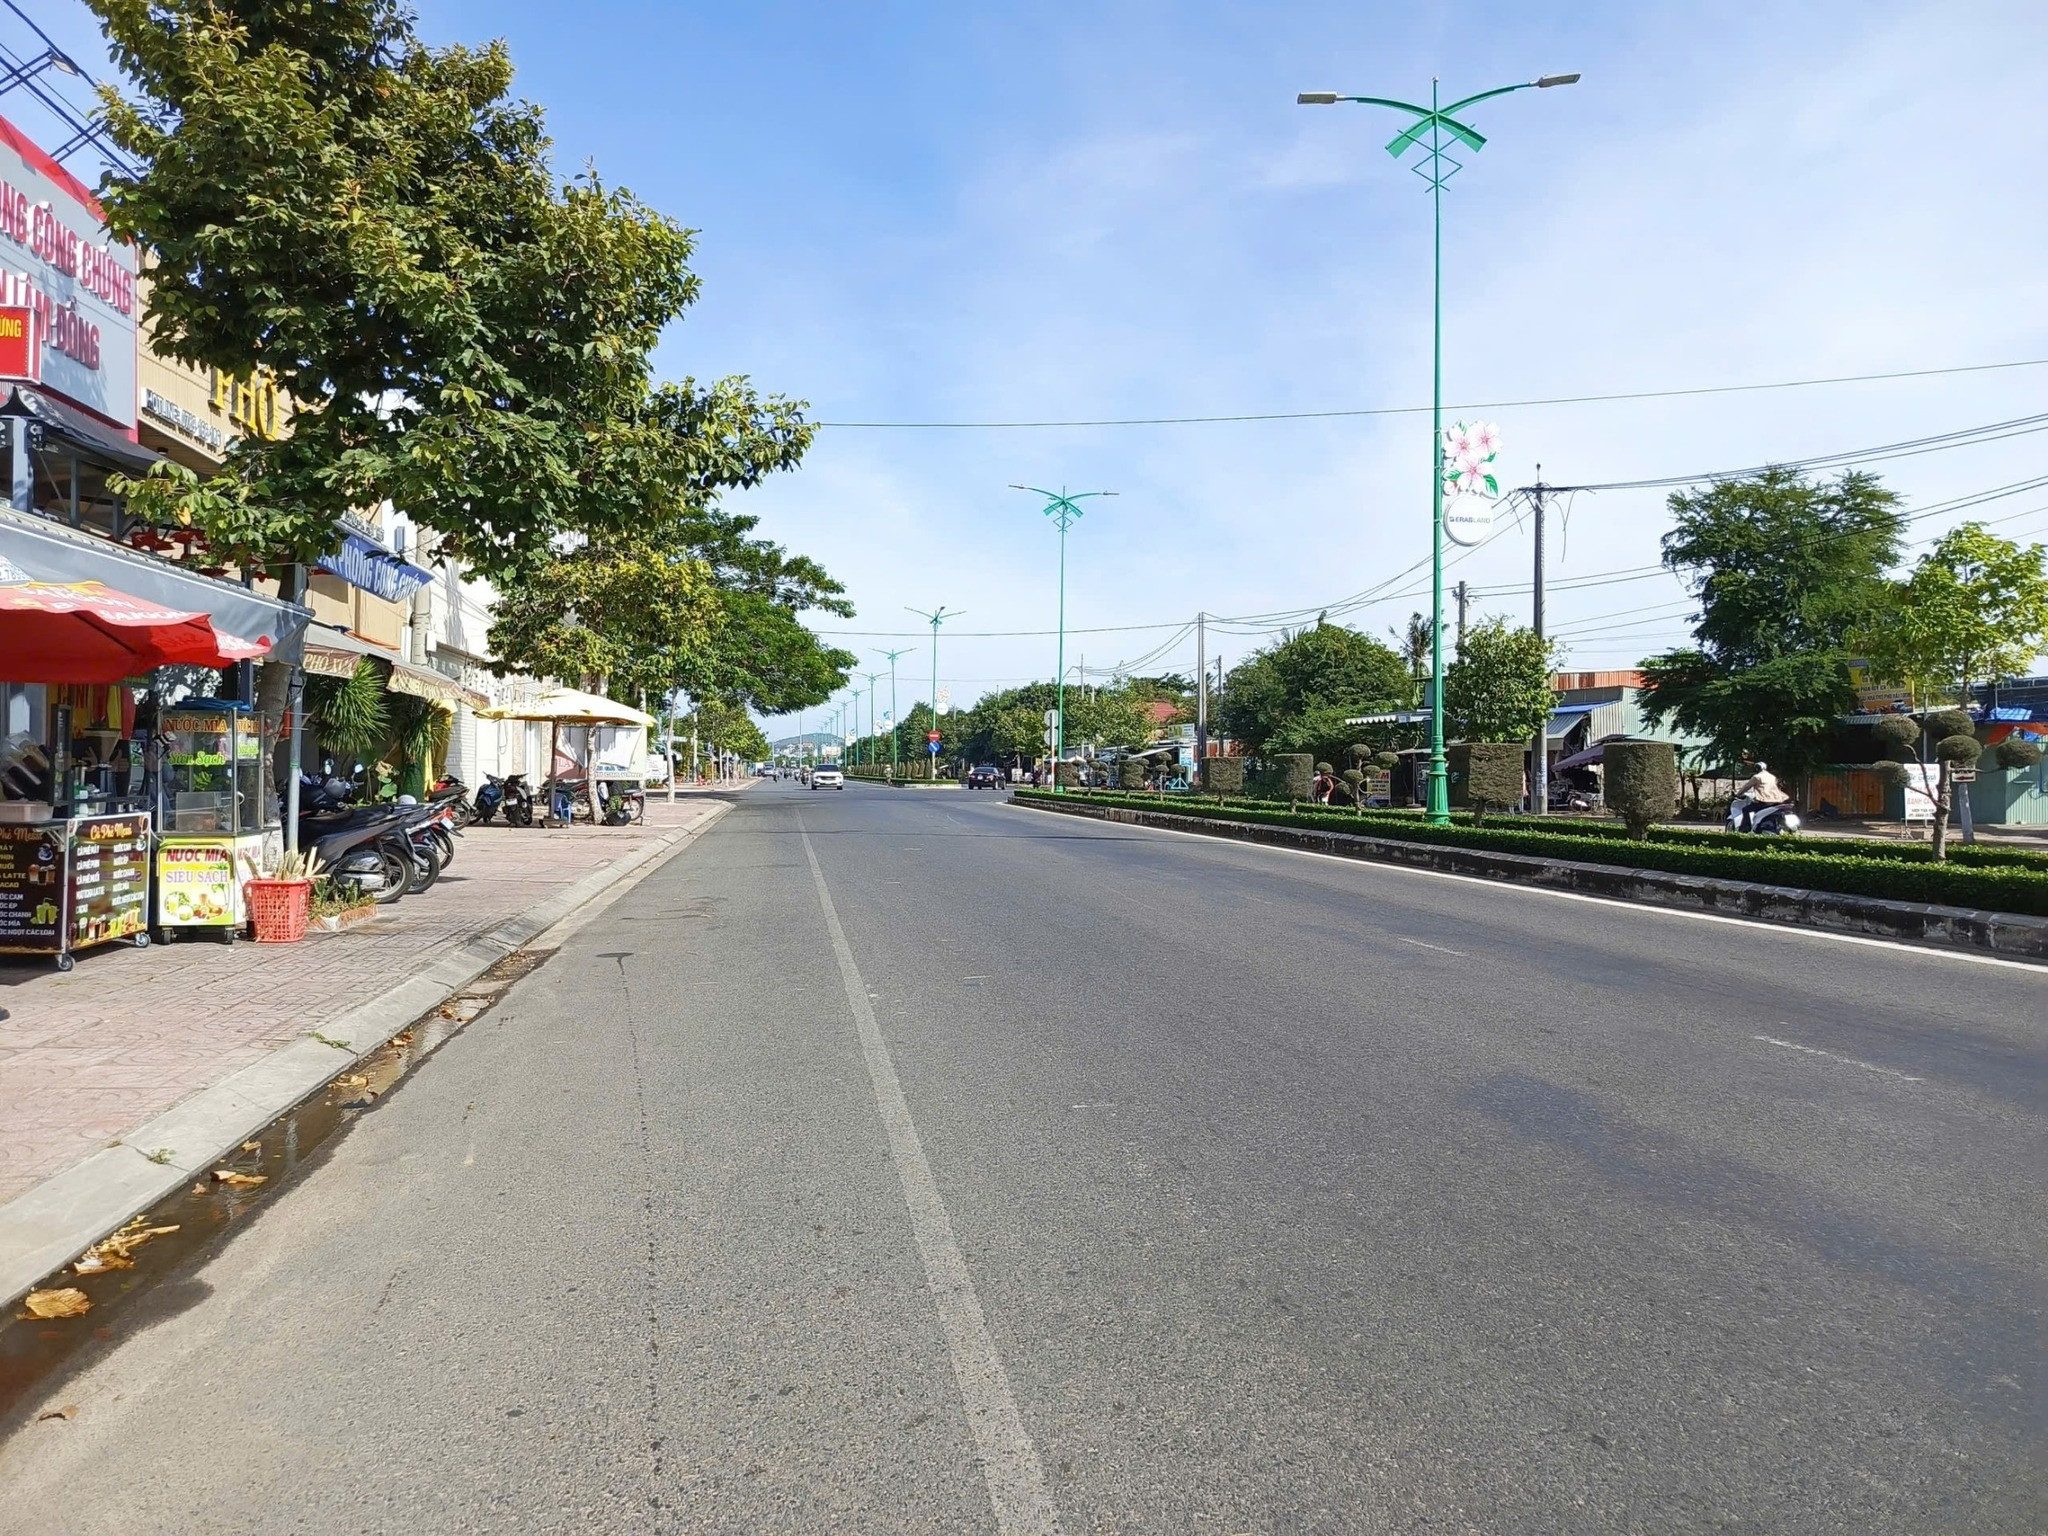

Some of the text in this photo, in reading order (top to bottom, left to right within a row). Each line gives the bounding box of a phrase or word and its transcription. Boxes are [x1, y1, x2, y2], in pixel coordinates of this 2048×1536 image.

[0, 180, 28, 245] NG
[32, 203, 78, 278] CÔNG
[82, 241, 132, 315] CHỨNG
